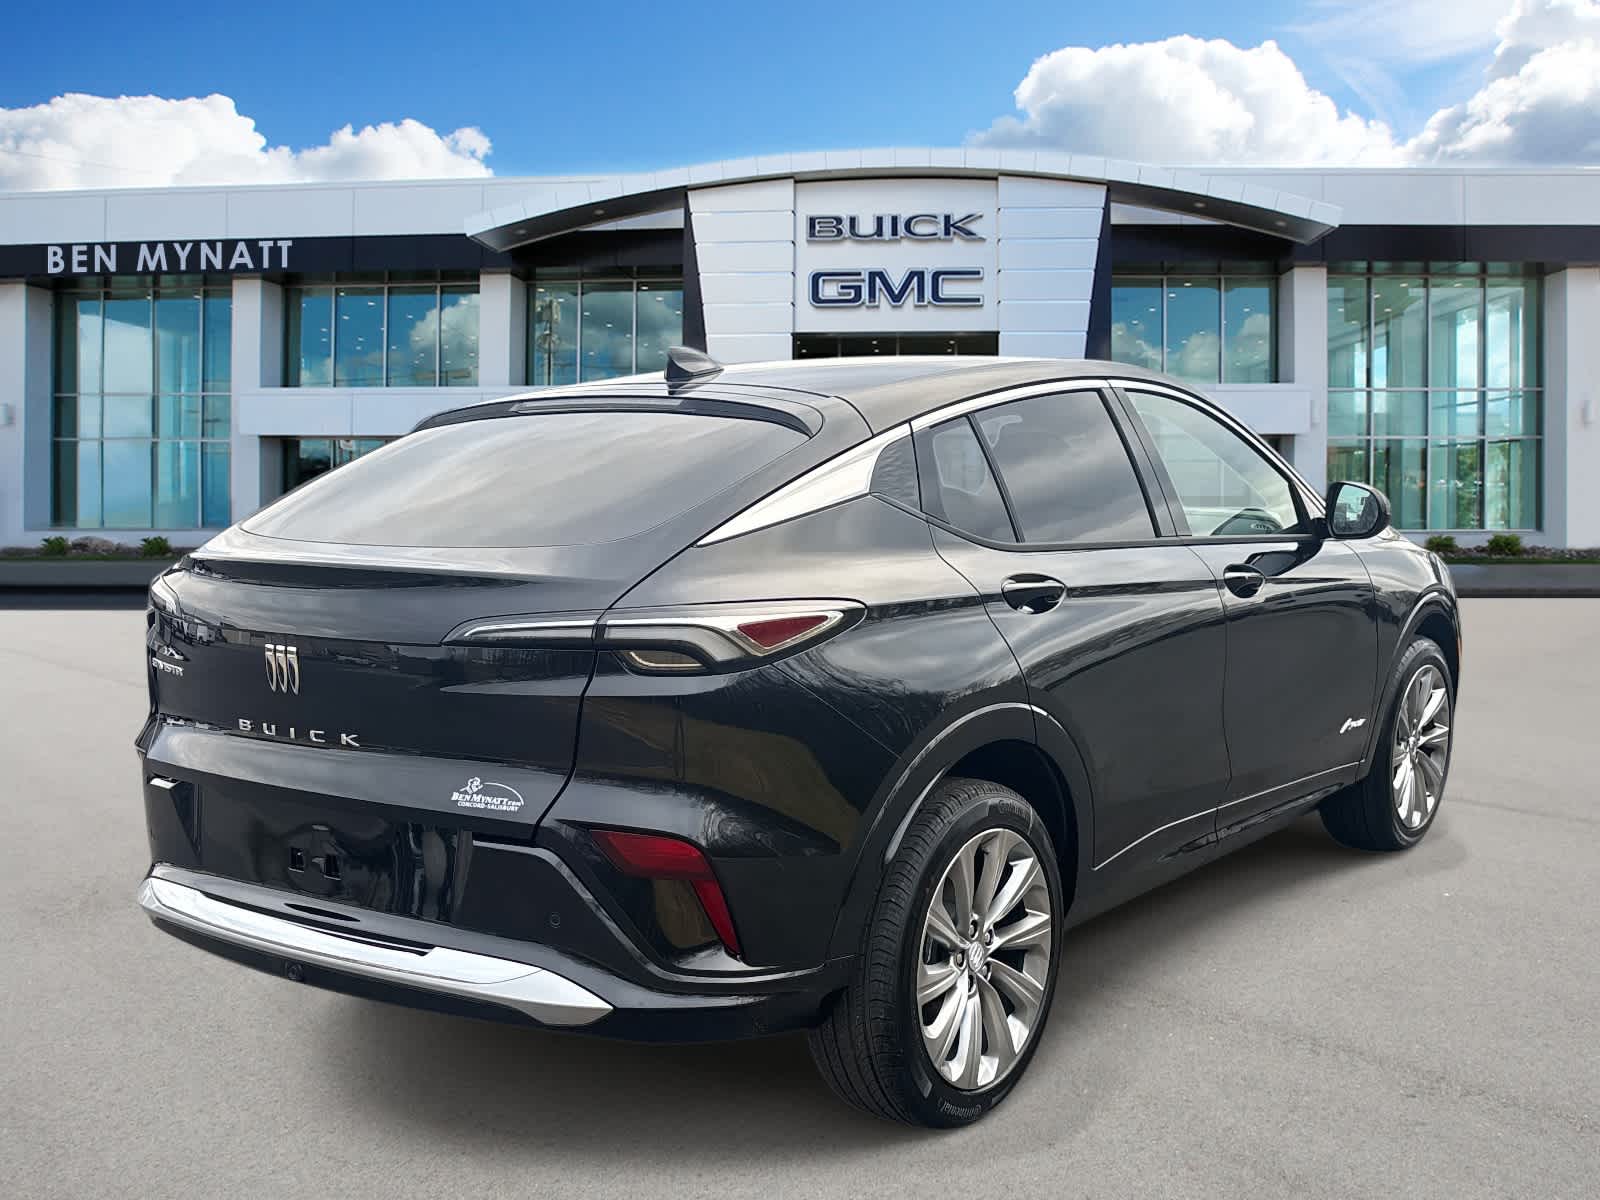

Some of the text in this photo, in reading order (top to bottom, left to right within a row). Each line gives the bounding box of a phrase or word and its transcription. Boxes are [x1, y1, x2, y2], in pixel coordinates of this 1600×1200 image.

[806, 213, 986, 241] BUICK
[47, 240, 293, 274] BEN MYNATT
[809, 268, 984, 308] GMC
[238, 718, 360, 748] BUICK
